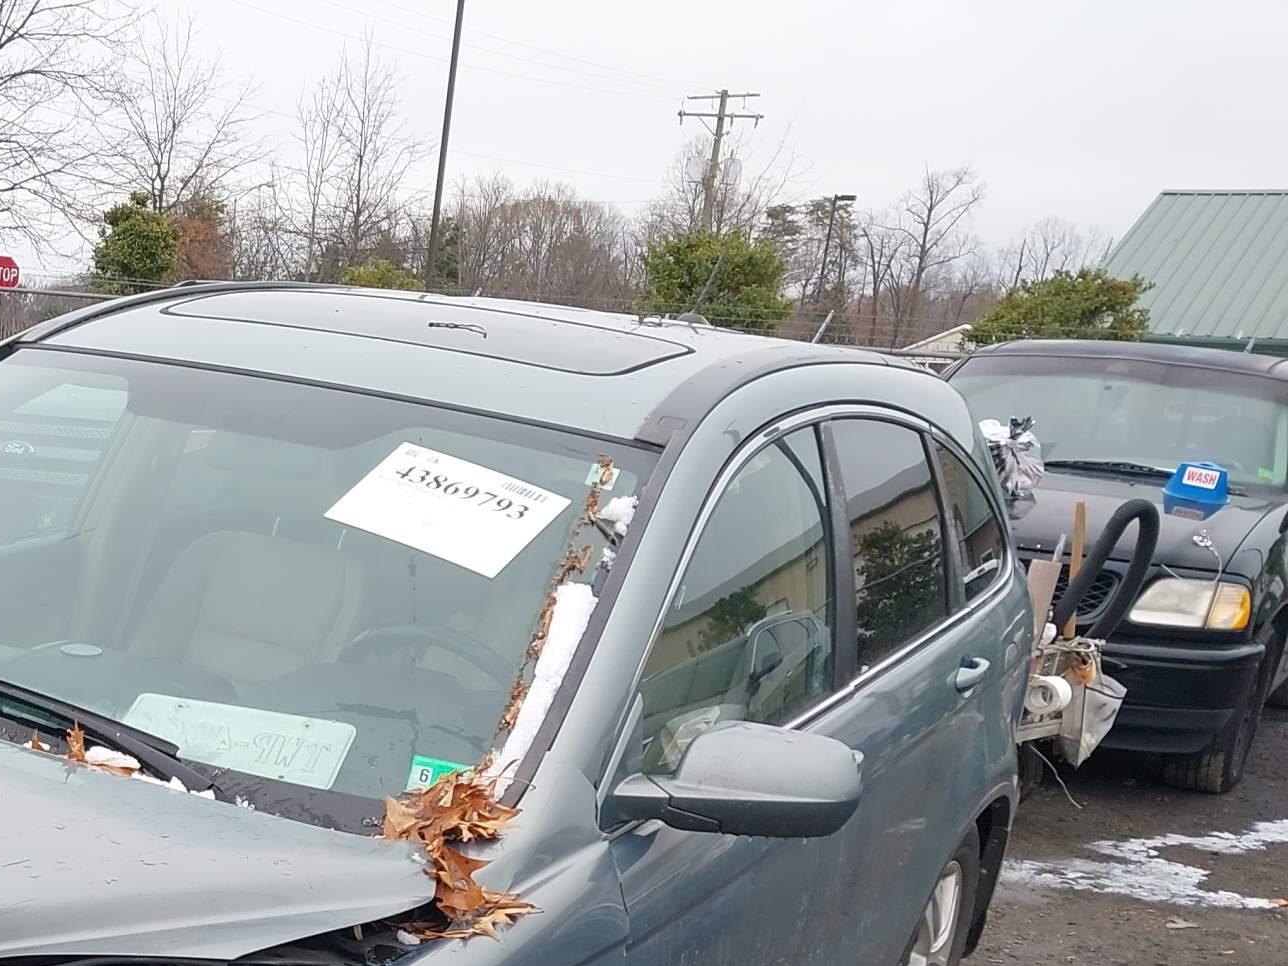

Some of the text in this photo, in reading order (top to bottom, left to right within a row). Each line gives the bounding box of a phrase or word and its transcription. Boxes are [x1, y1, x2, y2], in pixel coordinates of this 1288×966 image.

[1186, 470, 1217, 486] WASH
[395, 465, 531, 520] 43869793
[418, 768, 430, 783] 6
